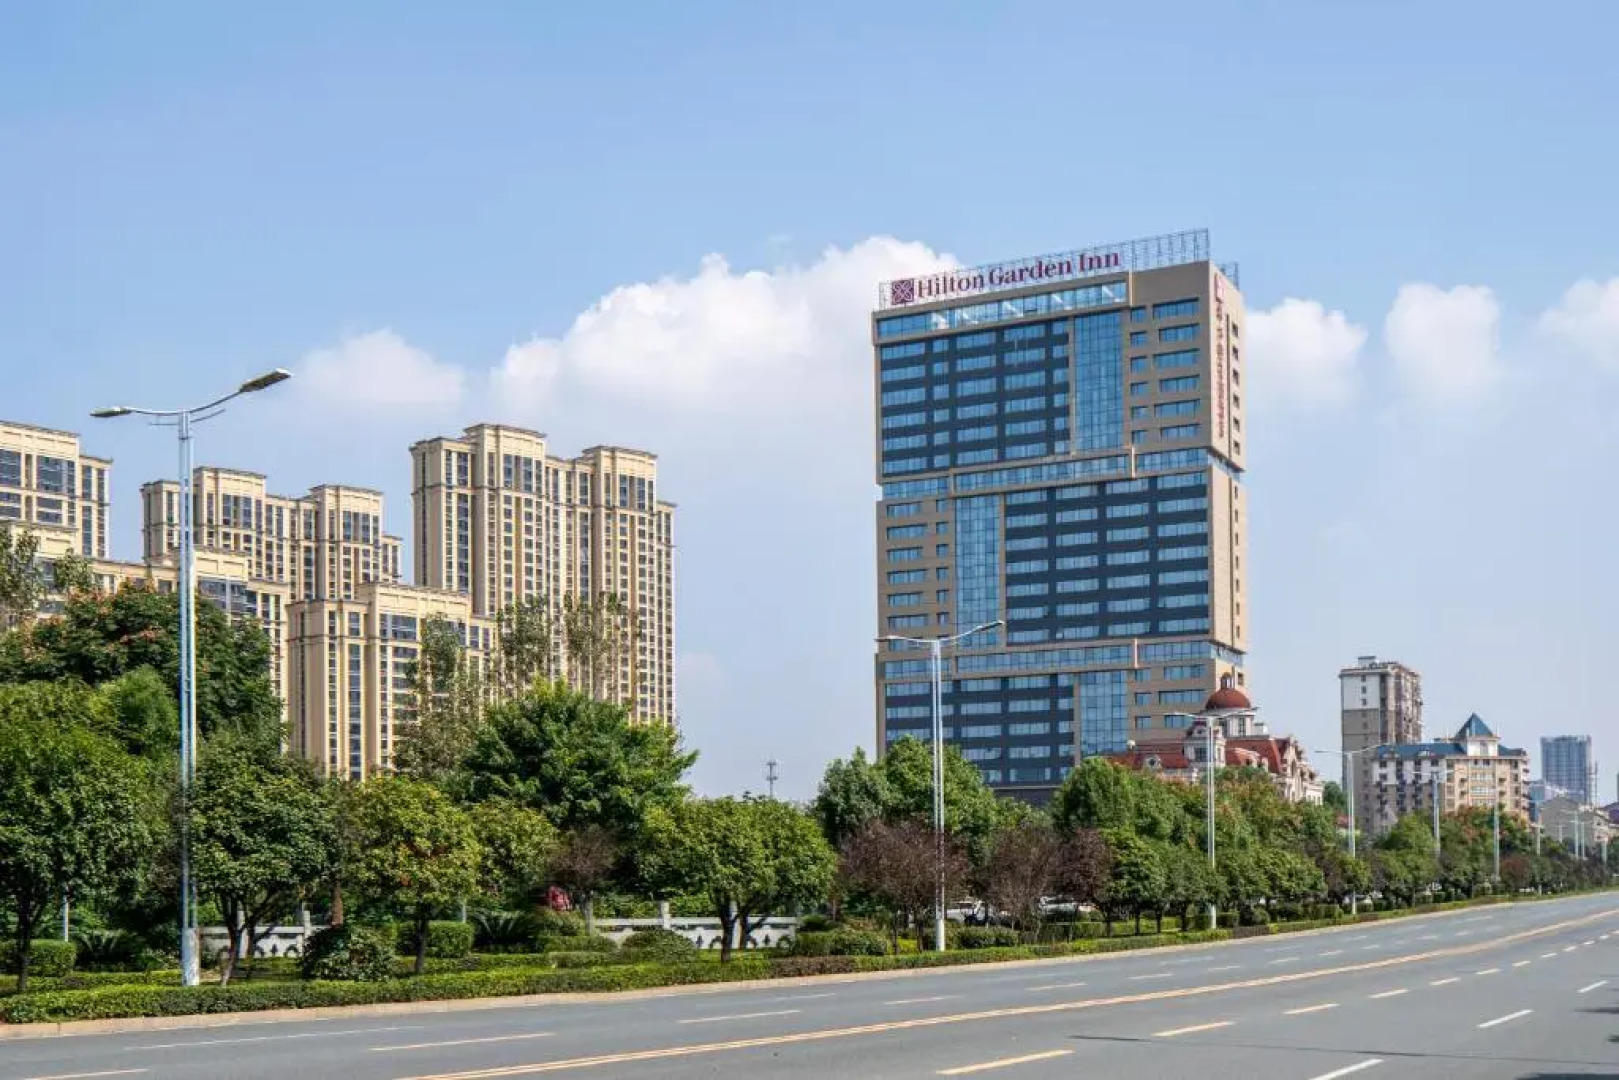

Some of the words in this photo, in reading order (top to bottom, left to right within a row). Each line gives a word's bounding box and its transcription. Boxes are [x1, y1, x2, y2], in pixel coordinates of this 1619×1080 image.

[918, 274, 985, 298] Hilton
[989, 260, 1072, 286] Garden
[1079, 252, 1120, 273] Inn
